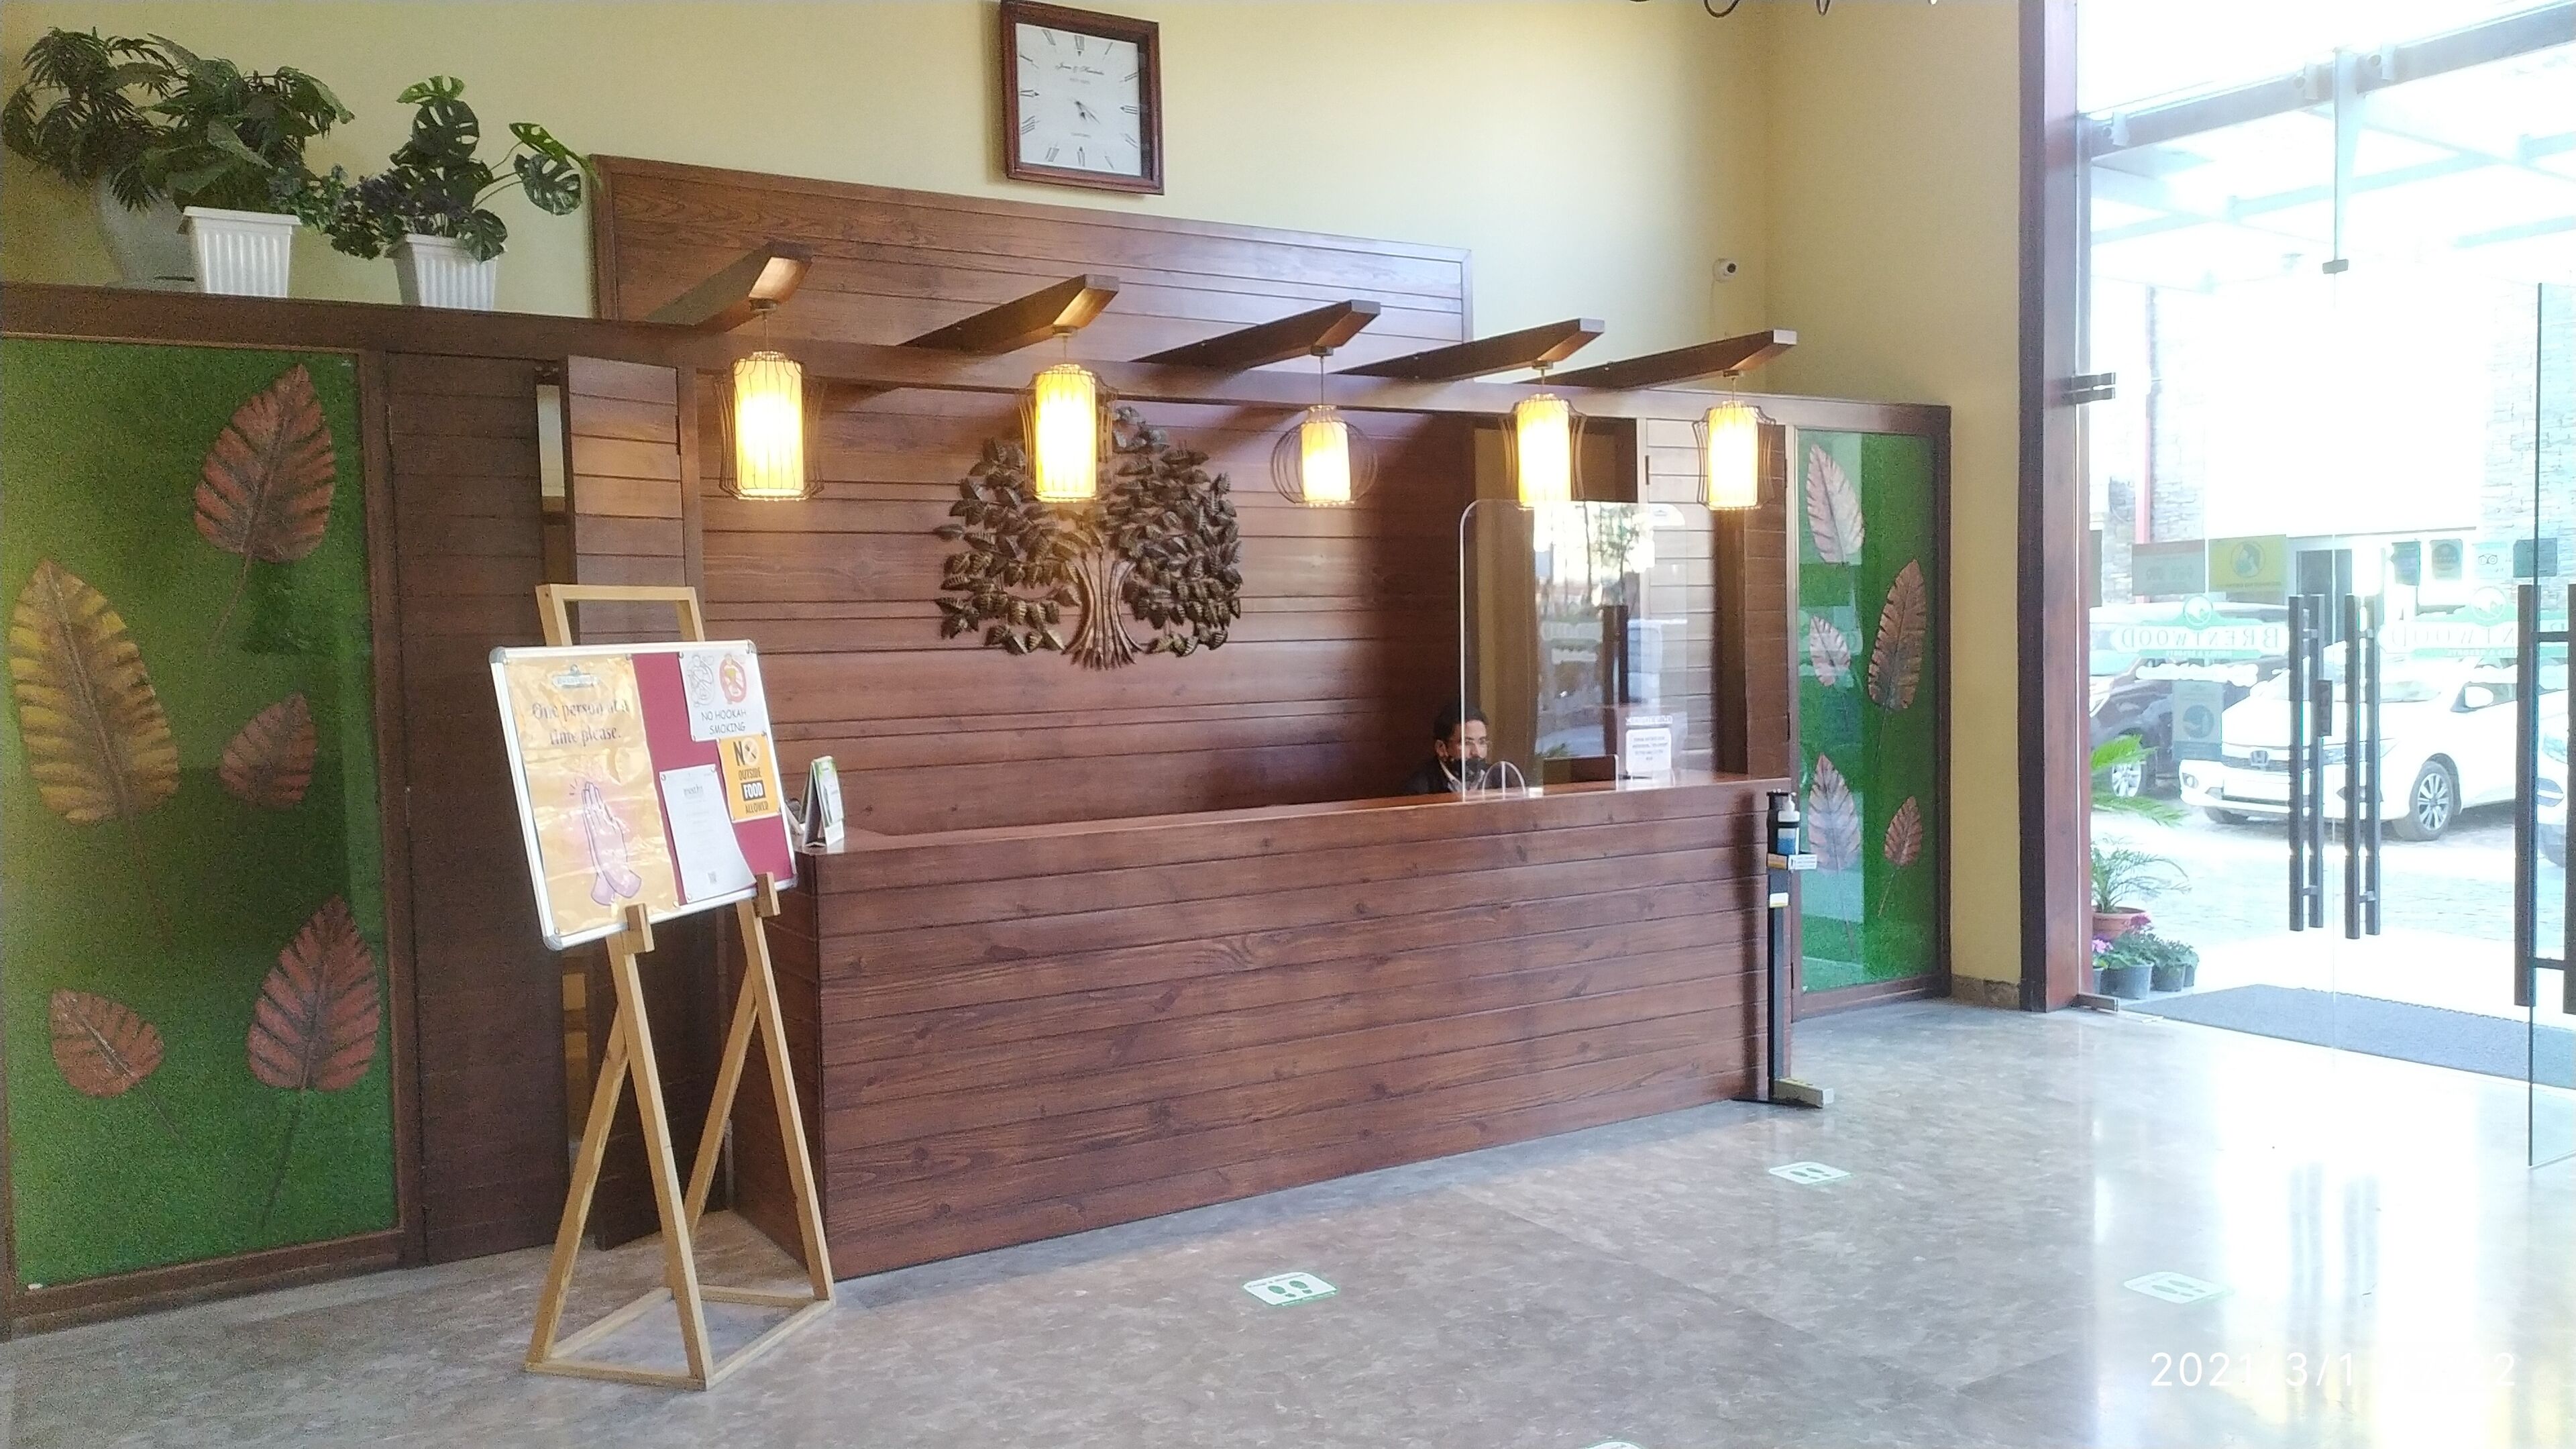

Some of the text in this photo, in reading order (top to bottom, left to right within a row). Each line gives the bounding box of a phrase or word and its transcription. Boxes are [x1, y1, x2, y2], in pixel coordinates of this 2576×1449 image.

[532, 702, 559, 719] One
[561, 703, 603, 722] person
[701, 709, 747, 721] NO HOOKAH
[710, 722, 745, 735] SMOKING
[582, 724, 621, 747] please.
[738, 767, 762, 780] OUTSIDE
[743, 782, 764, 799] FOOD
[745, 801, 769, 814] ALLOWED
